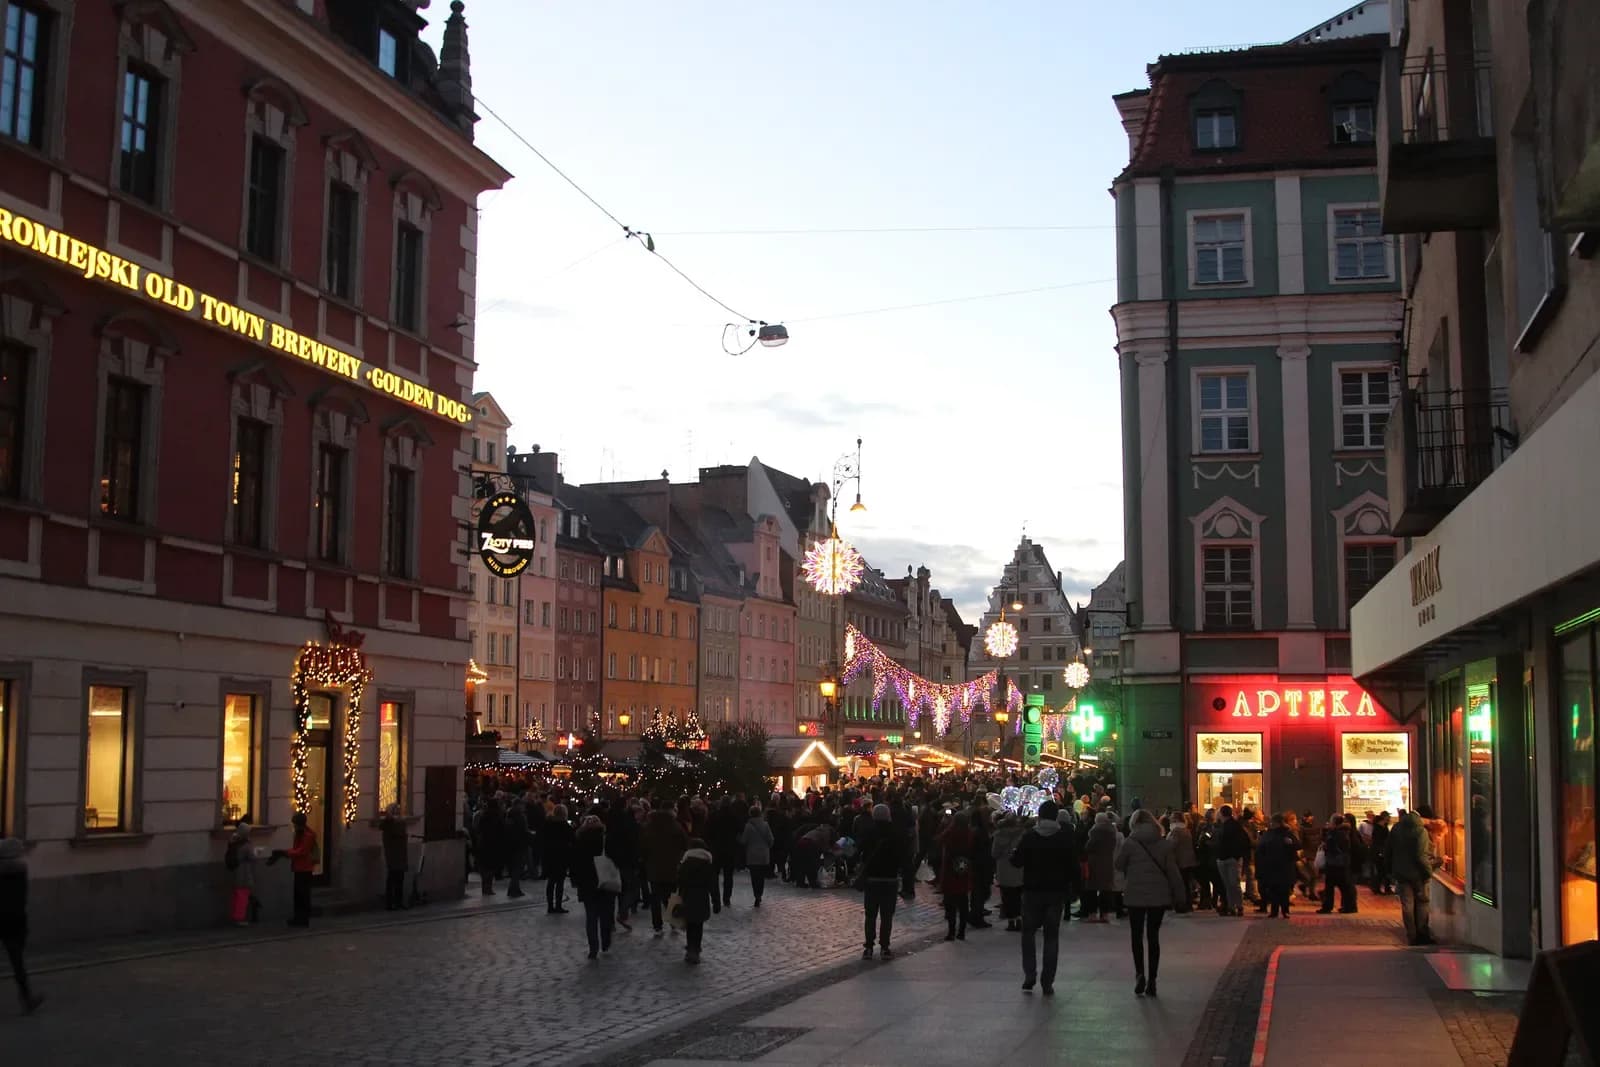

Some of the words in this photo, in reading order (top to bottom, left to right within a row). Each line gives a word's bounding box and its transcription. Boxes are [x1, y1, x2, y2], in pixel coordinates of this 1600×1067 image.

[145, 272, 195, 312] OLD
[200, 293, 265, 341] TOWN
[270, 323, 361, 380] BREWERY
[1232, 689, 1376, 717] APTEKA
